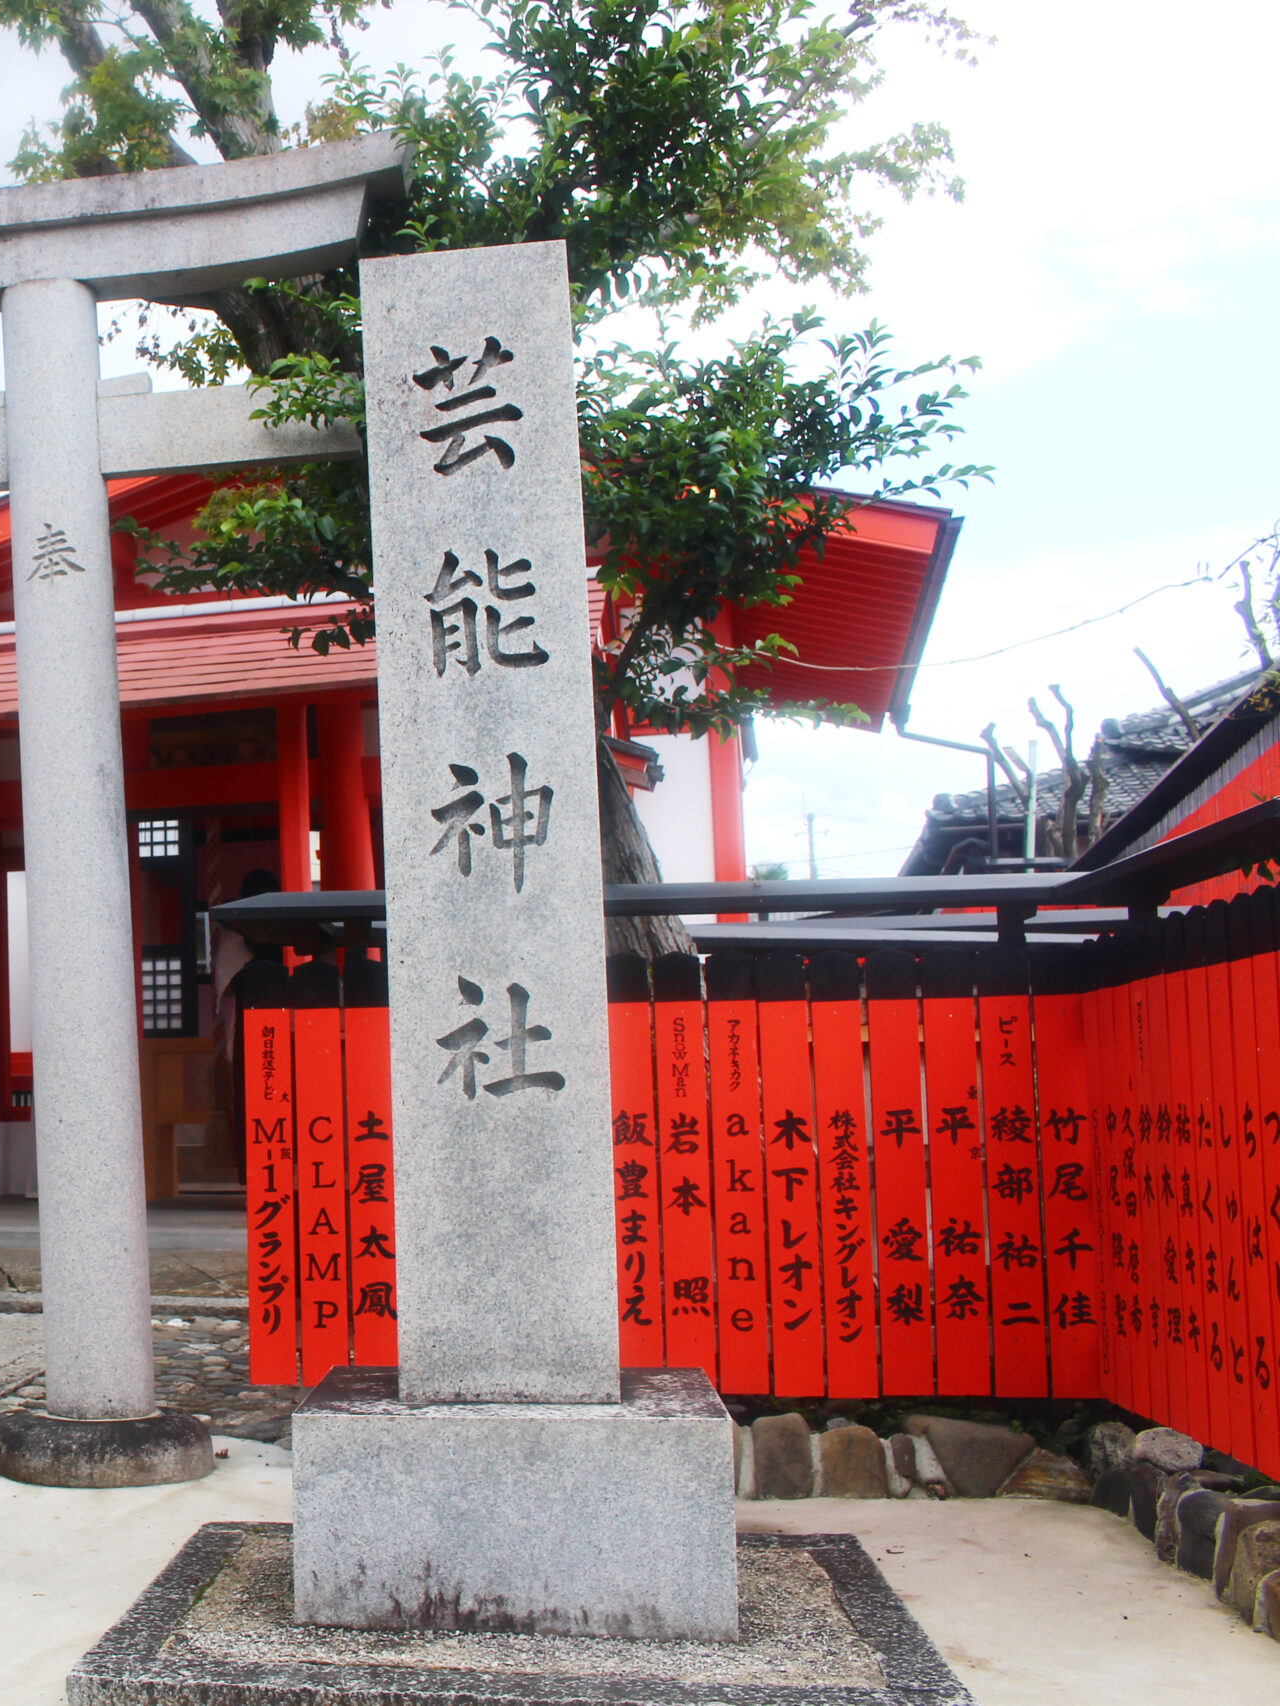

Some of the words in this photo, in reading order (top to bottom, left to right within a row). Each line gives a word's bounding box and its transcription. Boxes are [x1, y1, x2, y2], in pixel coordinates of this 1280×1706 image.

[26, 522, 86, 582] 奉
[412, 335, 566, 1100] 芸能神社
[261, 1025, 276, 1101] 朝日放送テレビ
[279, 1091, 292, 1160] 大阪
[671, 1063, 689, 1098] Man
[726, 1018, 741, 1092] アカネキカク
[966, 1084, 986, 1160] 東京
[998, 1015, 1018, 1068] ピース
[252, 1118, 290, 1336] M-1グランプリ
[304, 1115, 342, 1329] CLAMP
[351, 1110, 397, 1320] 土屋太鳳
[612, 1109, 653, 1326] 飯豊まりえ
[664, 1112, 710, 1317] 岩本照
[725, 1113, 756, 1332] akane
[769, 1108, 813, 1332] 木下レオン
[826, 1109, 865, 1343] 株式会社キングレオン
[880, 1109, 925, 1327] 平愛梨
[934, 1105, 985, 1321] 平祐奈
[989, 1104, 1041, 1327] 綾部祐二
[1043, 1105, 1098, 1331] 竹尾千佳
[1106, 1104, 1128, 1338] 中尾隆聖
[1156, 1104, 1183, 1344] 鈴木愛理
[1175, 1103, 1200, 1353] 祐真キキ
[1198, 1103, 1223, 1371] たくまる
[1219, 1105, 1244, 1385] しゅんと
[1242, 1100, 1270, 1390] ちはる
